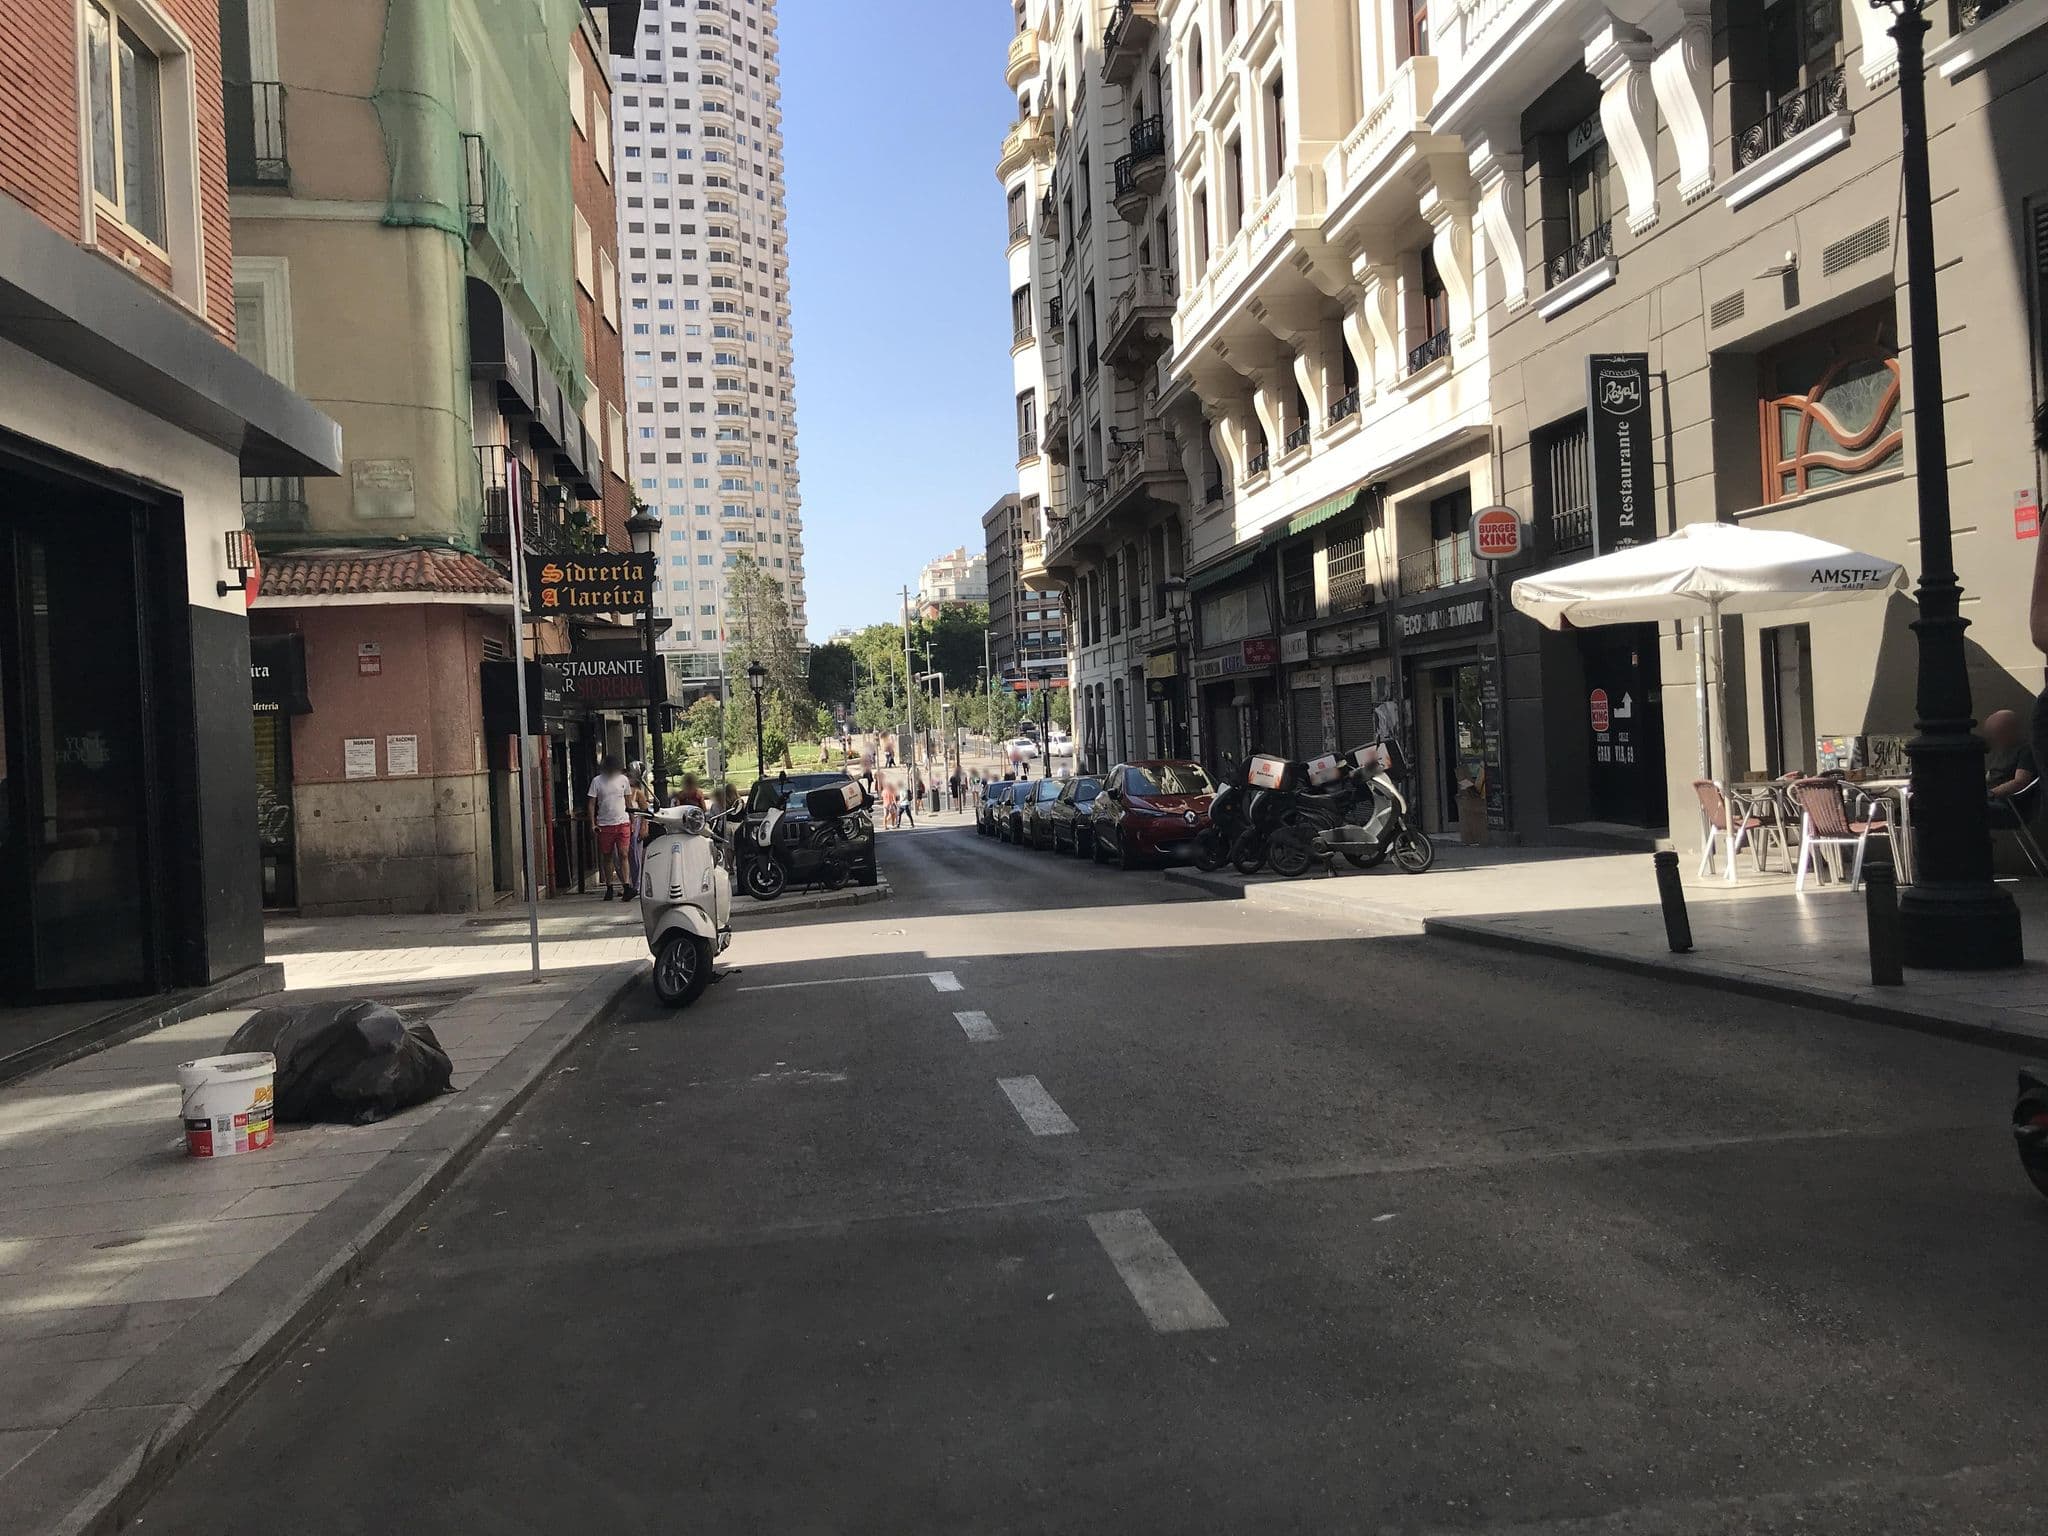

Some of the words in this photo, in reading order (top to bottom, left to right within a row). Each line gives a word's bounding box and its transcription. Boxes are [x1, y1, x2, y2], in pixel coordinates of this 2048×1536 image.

[1618, 421, 1634, 527] Restaurante
[1479, 524, 1516, 534] BURGER
[1480, 533, 1517, 545] KING
[1810, 569, 1880, 583] AMSTEL
[1404, 614, 1421, 636] ECO
[1456, 601, 1481, 625] WAY
